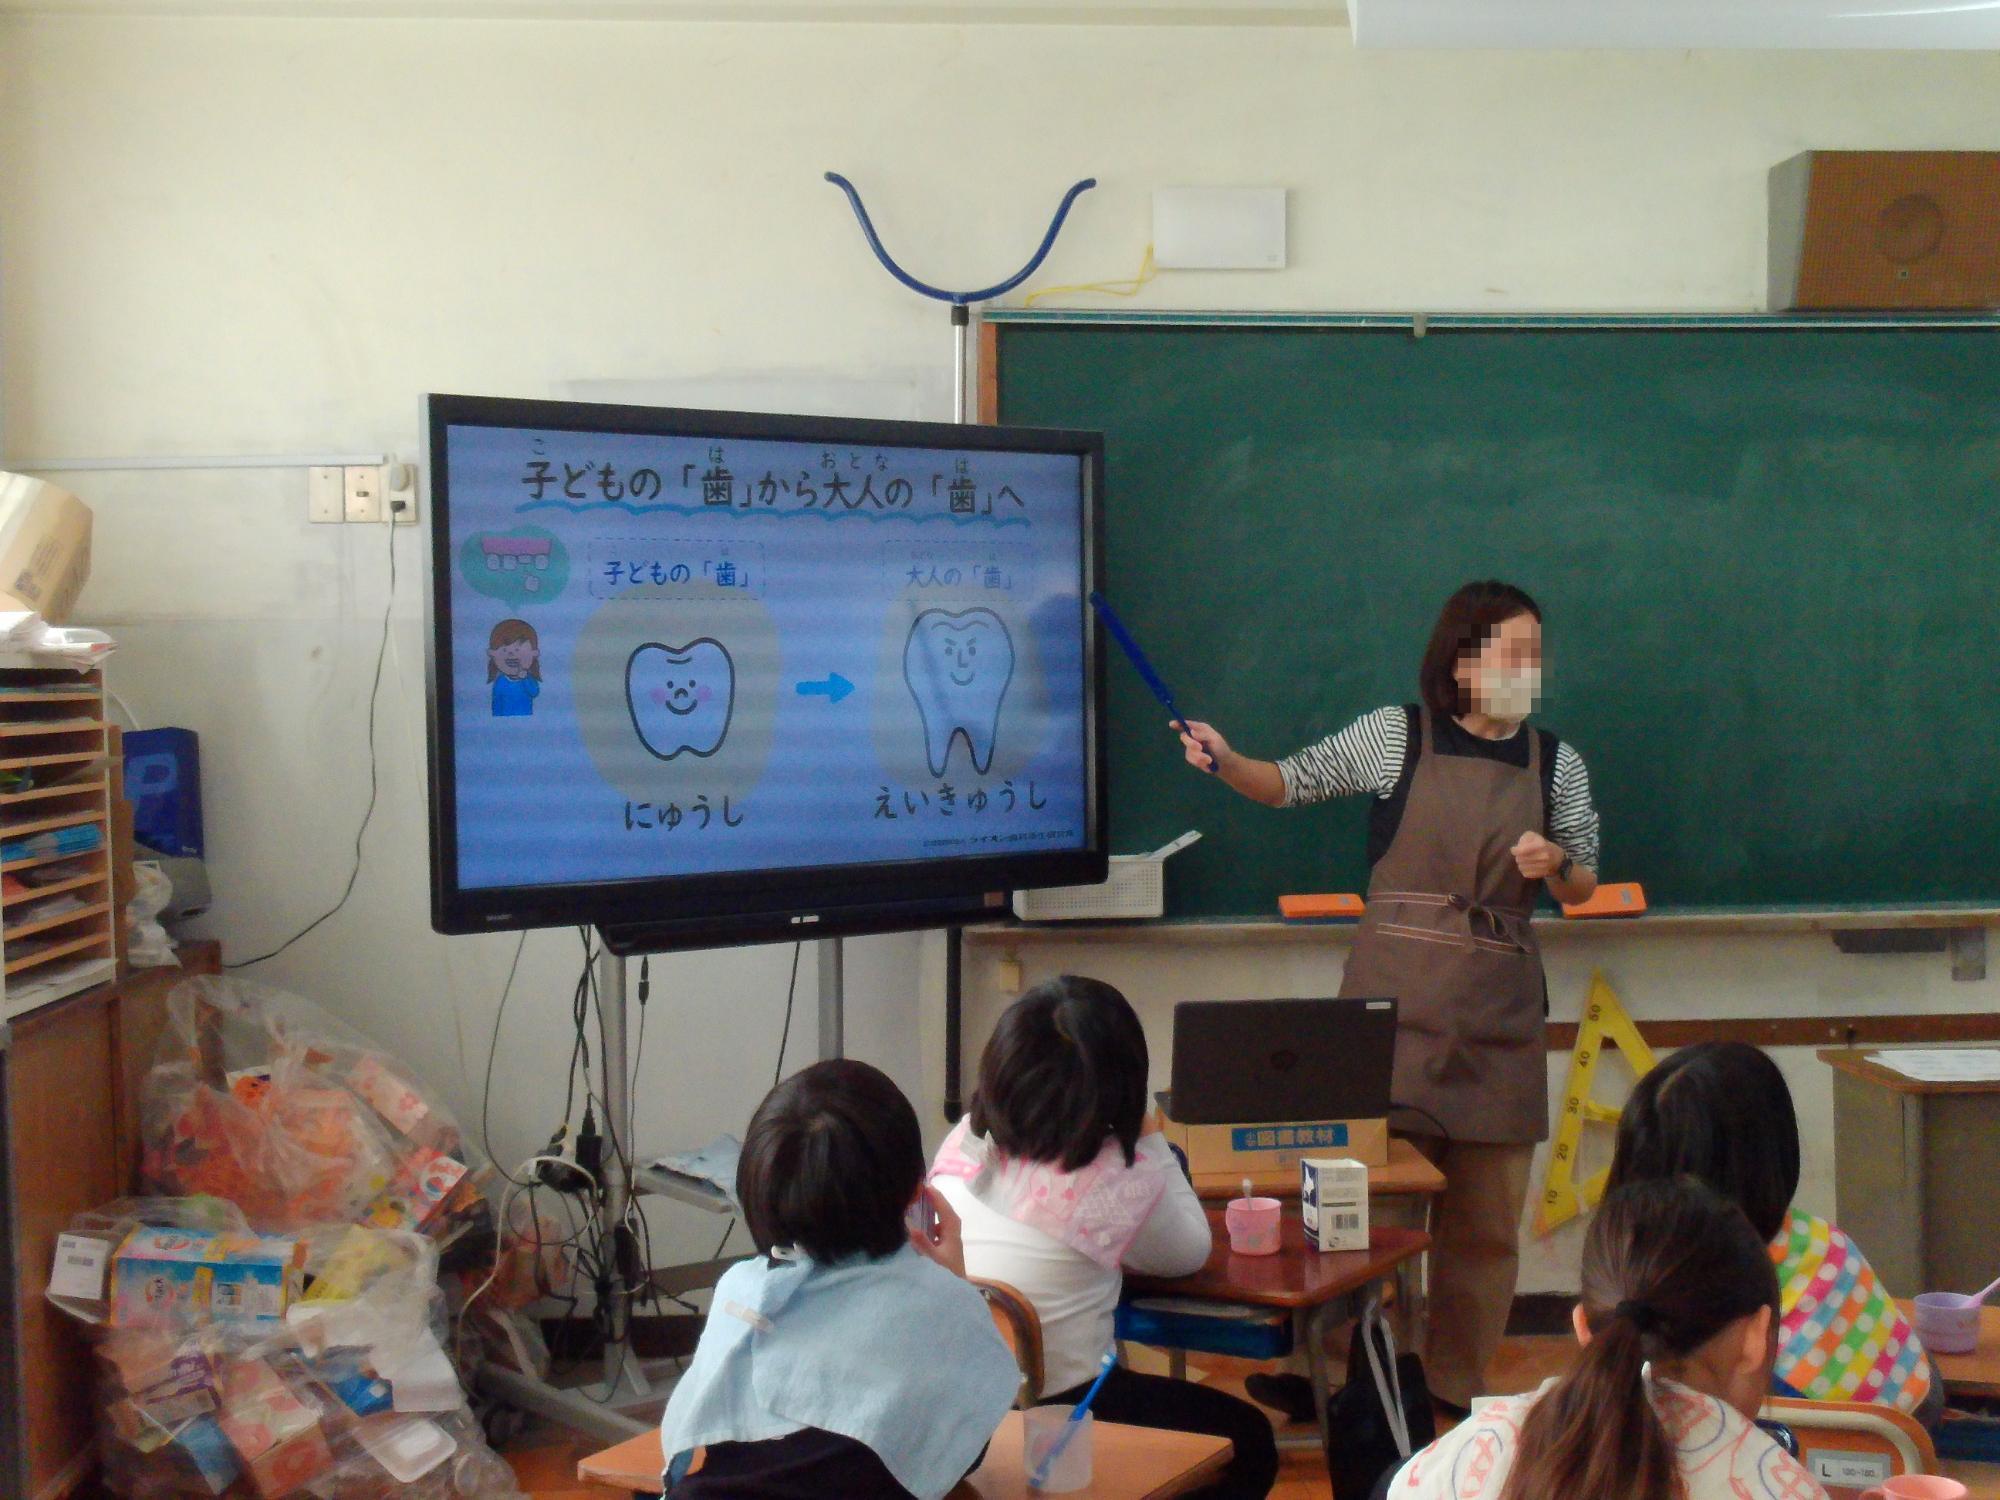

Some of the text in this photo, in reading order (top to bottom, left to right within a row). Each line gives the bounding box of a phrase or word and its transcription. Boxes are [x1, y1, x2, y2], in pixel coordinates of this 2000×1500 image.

[604, 560, 748, 588] 子どもの「歯」
[906, 564, 1012, 590] 大人の「歯」
[874, 780, 1047, 819] えいきゅうし
[625, 794, 744, 832] にゅうし
[1578, 1050, 1590, 1068] 40
[1557, 1143, 1569, 1161] 20
[1821, 1463, 1832, 1478] L
